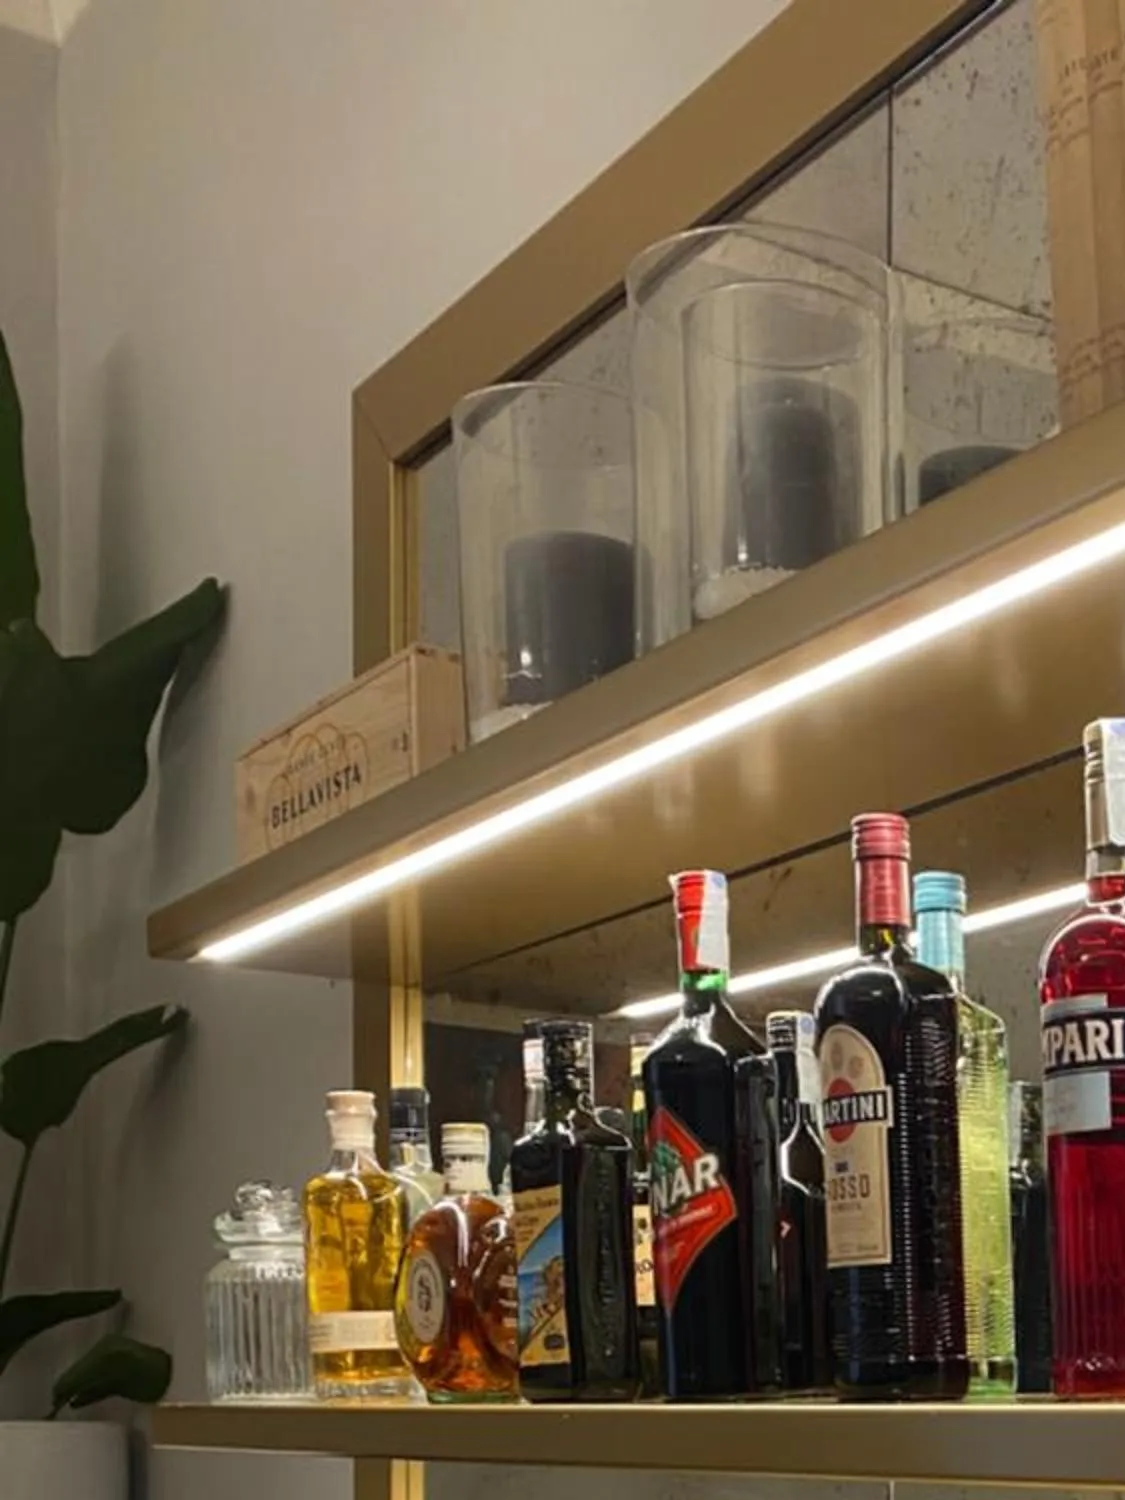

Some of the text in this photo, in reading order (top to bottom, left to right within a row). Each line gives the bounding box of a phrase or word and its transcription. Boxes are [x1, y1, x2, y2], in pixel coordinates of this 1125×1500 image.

[270, 761, 363, 830] BELLAVISTA
[824, 1090, 885, 1127] ARTINI
[653, 1153, 720, 1217] NAR
[828, 1172, 872, 1201] OSSO
